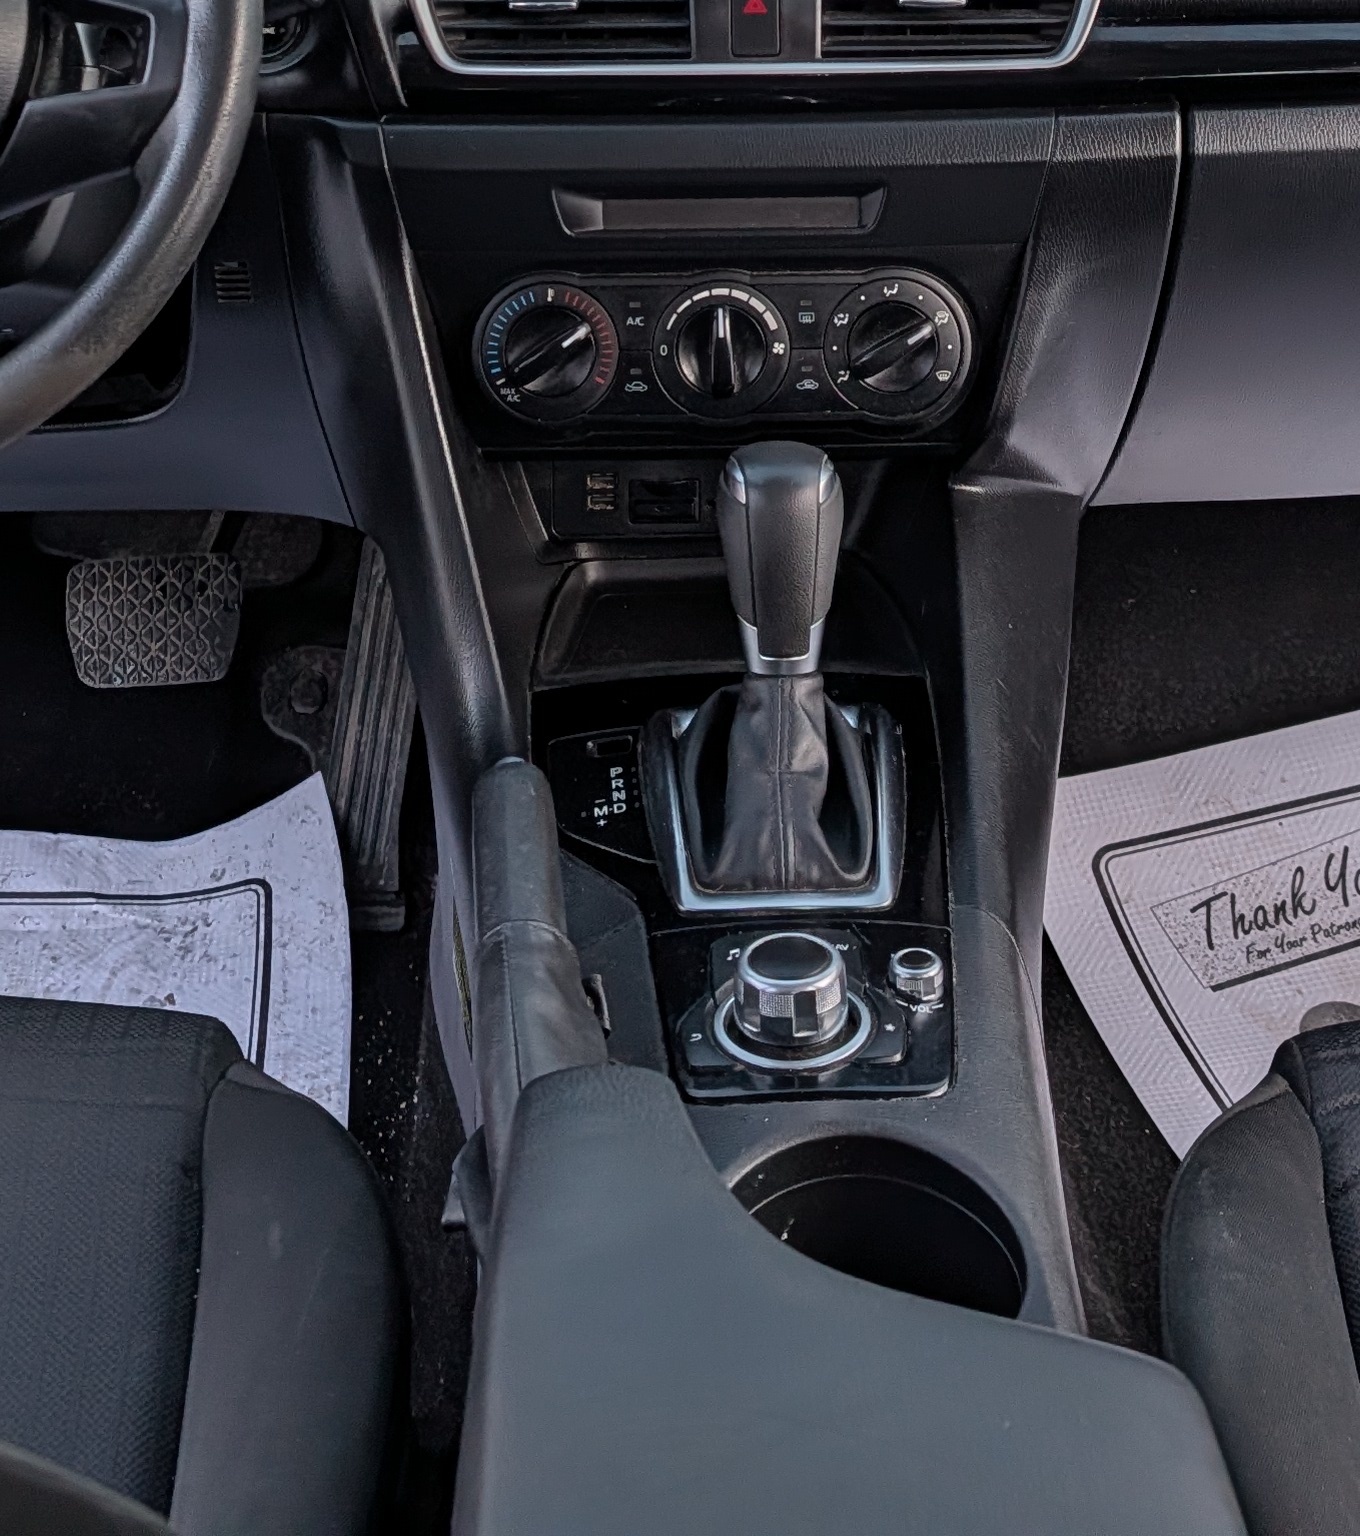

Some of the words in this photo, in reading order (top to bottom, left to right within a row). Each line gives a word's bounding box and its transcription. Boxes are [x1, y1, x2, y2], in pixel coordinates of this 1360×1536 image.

[625, 316, 645, 327] A/C
[499, 387, 516, 396] MAX
[506, 394, 521, 403] A/C
[610, 767, 623, 778] P
[611, 779, 624, 790] R
[612, 790, 626, 802] N
[1189, 866, 1317, 951] Thank
[830, 943, 850, 951] AV
[1245, 941, 1272, 964] For
[1274, 932, 1308, 954] Your
[909, 1004, 933, 1014] VOL
